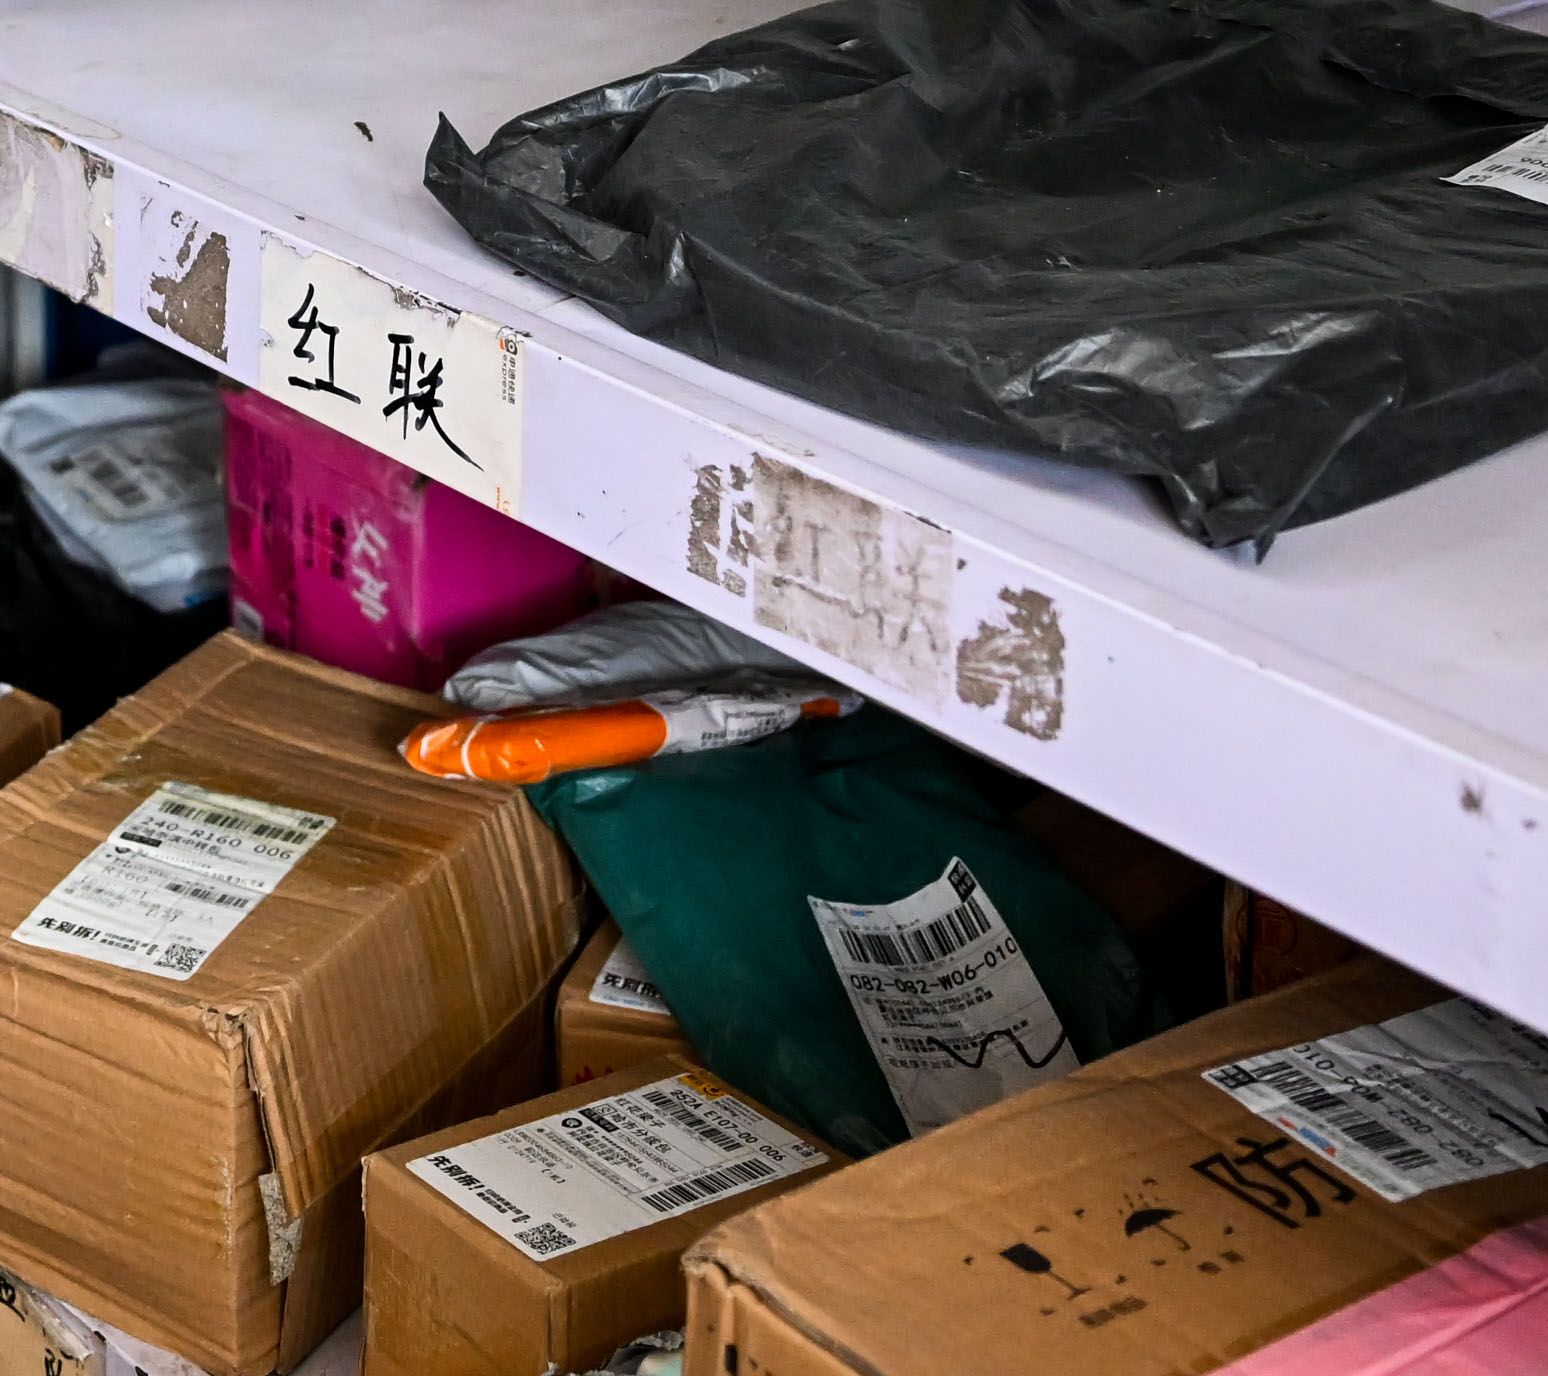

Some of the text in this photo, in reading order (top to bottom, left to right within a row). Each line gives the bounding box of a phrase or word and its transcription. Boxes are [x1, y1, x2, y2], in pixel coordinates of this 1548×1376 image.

[286, 283, 484, 473] 红联
[139, 815, 245, 848] 240-R160
[251, 842, 295, 860] 006
[35, 916, 102, 941] 先别拆!
[847, 935, 1018, 995] 082-082-W06-010
[667, 1089, 789, 1162] 252A E107-00 006
[424, 1153, 488, 1192] 先别拆!
[1191, 1136, 1358, 1229] 防
